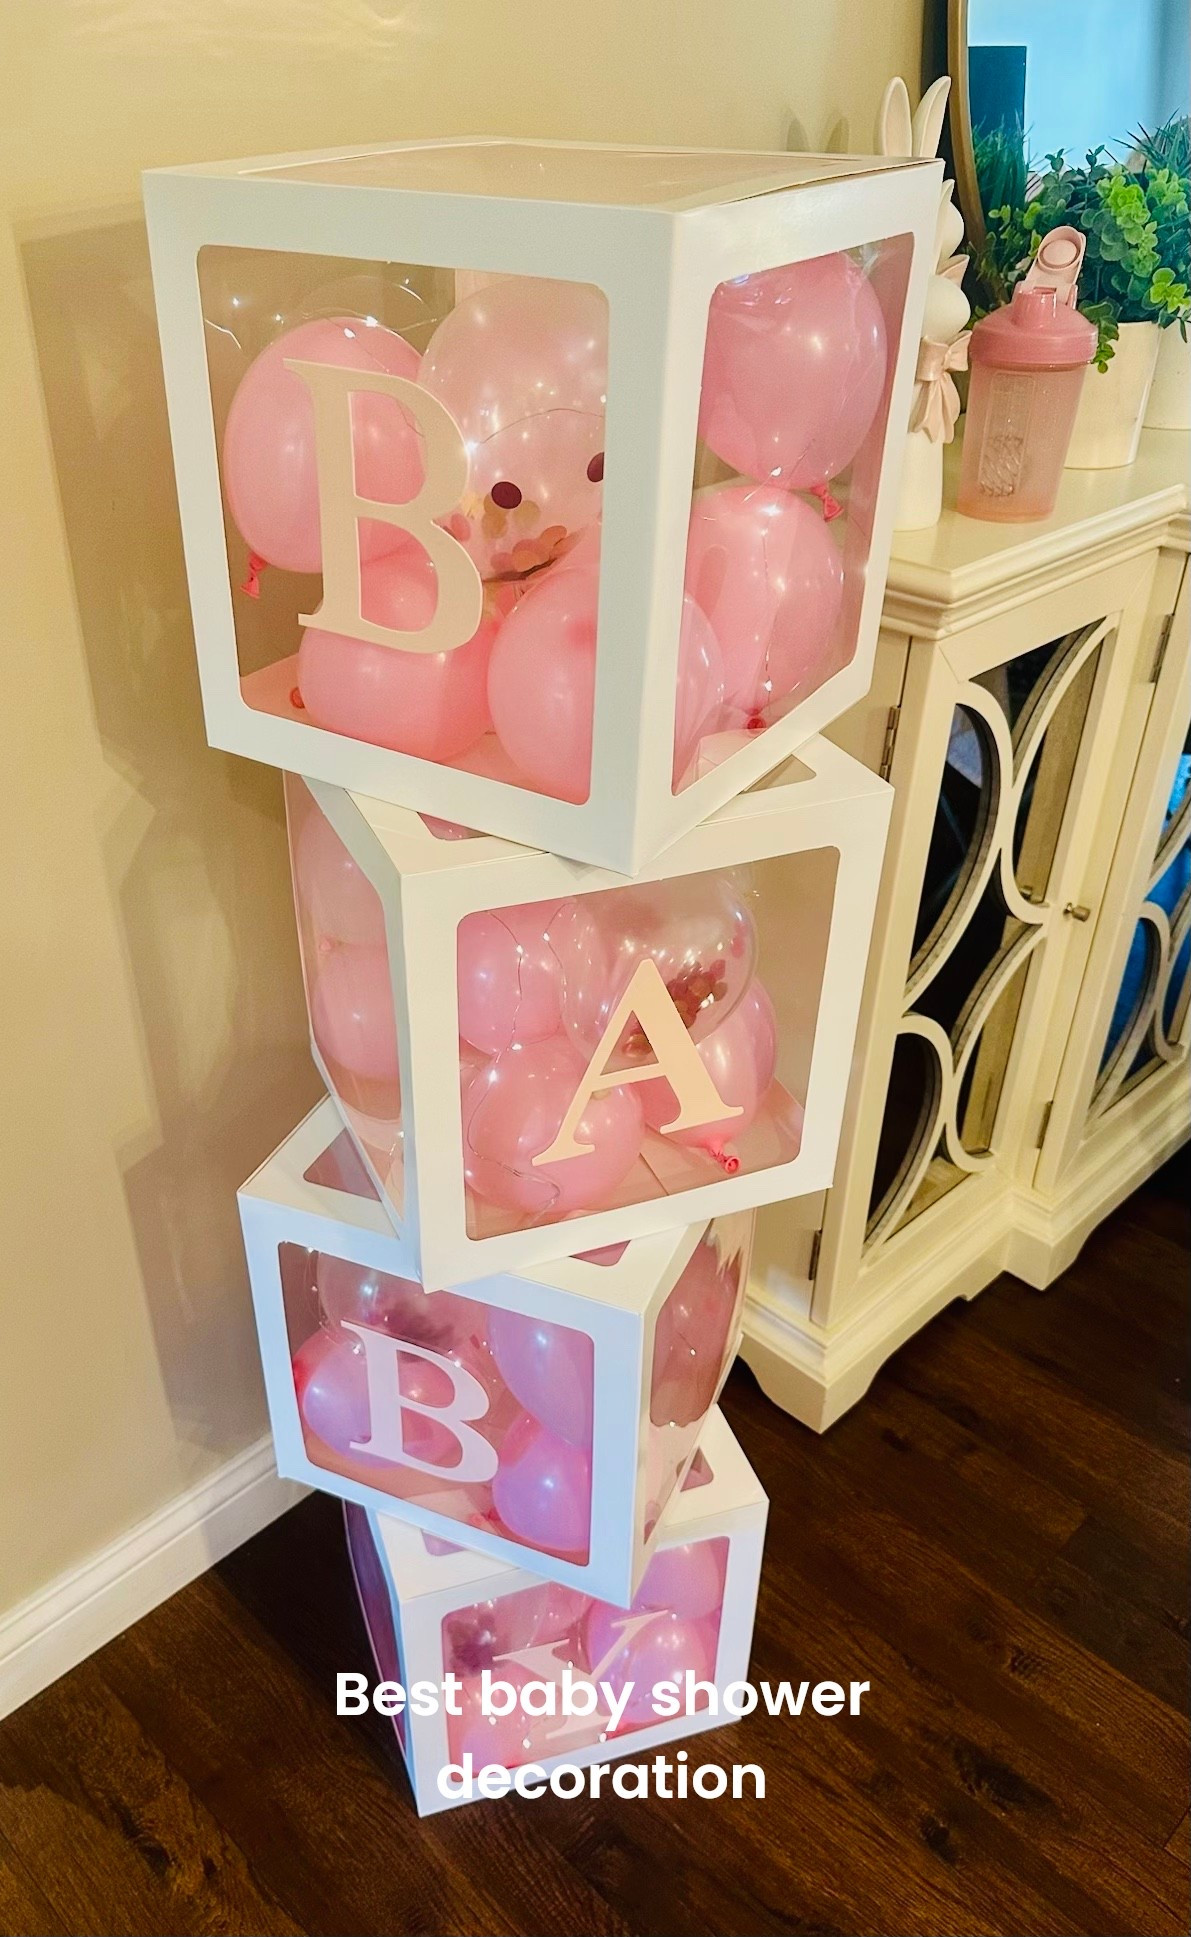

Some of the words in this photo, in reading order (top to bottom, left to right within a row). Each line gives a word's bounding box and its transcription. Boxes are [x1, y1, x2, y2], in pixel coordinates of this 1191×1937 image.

[283, 358, 482, 655] B
[532, 958, 744, 1167] A
[340, 1320, 499, 1482] B
[492, 1610, 669, 1740] Y
